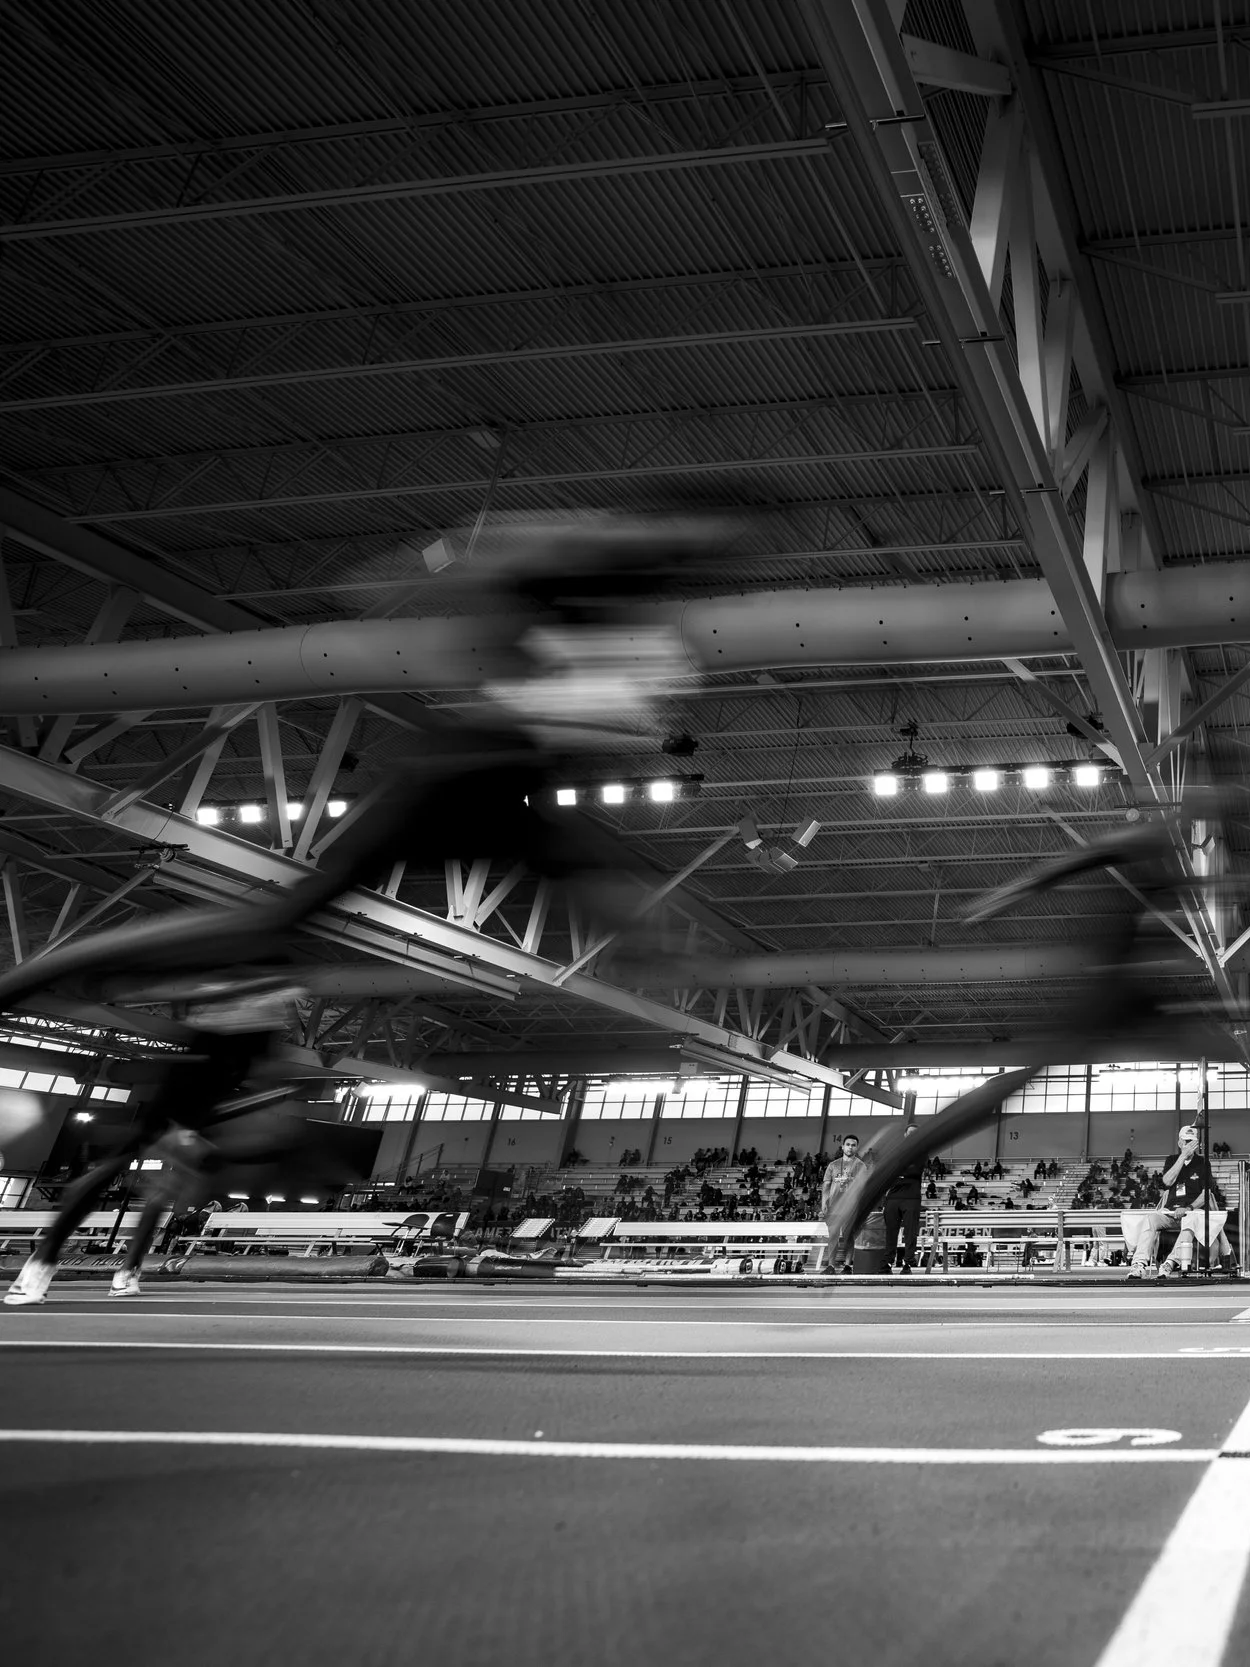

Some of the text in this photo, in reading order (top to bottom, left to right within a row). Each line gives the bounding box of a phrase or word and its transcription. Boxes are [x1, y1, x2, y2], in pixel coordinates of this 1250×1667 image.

[832, 1134, 842, 1143] 14
[1009, 1131, 1019, 1140] 13
[507, 1137, 517, 1146] 16
[663, 1136, 673, 1145] 15
[1036, 1428, 1183, 1446] 6
